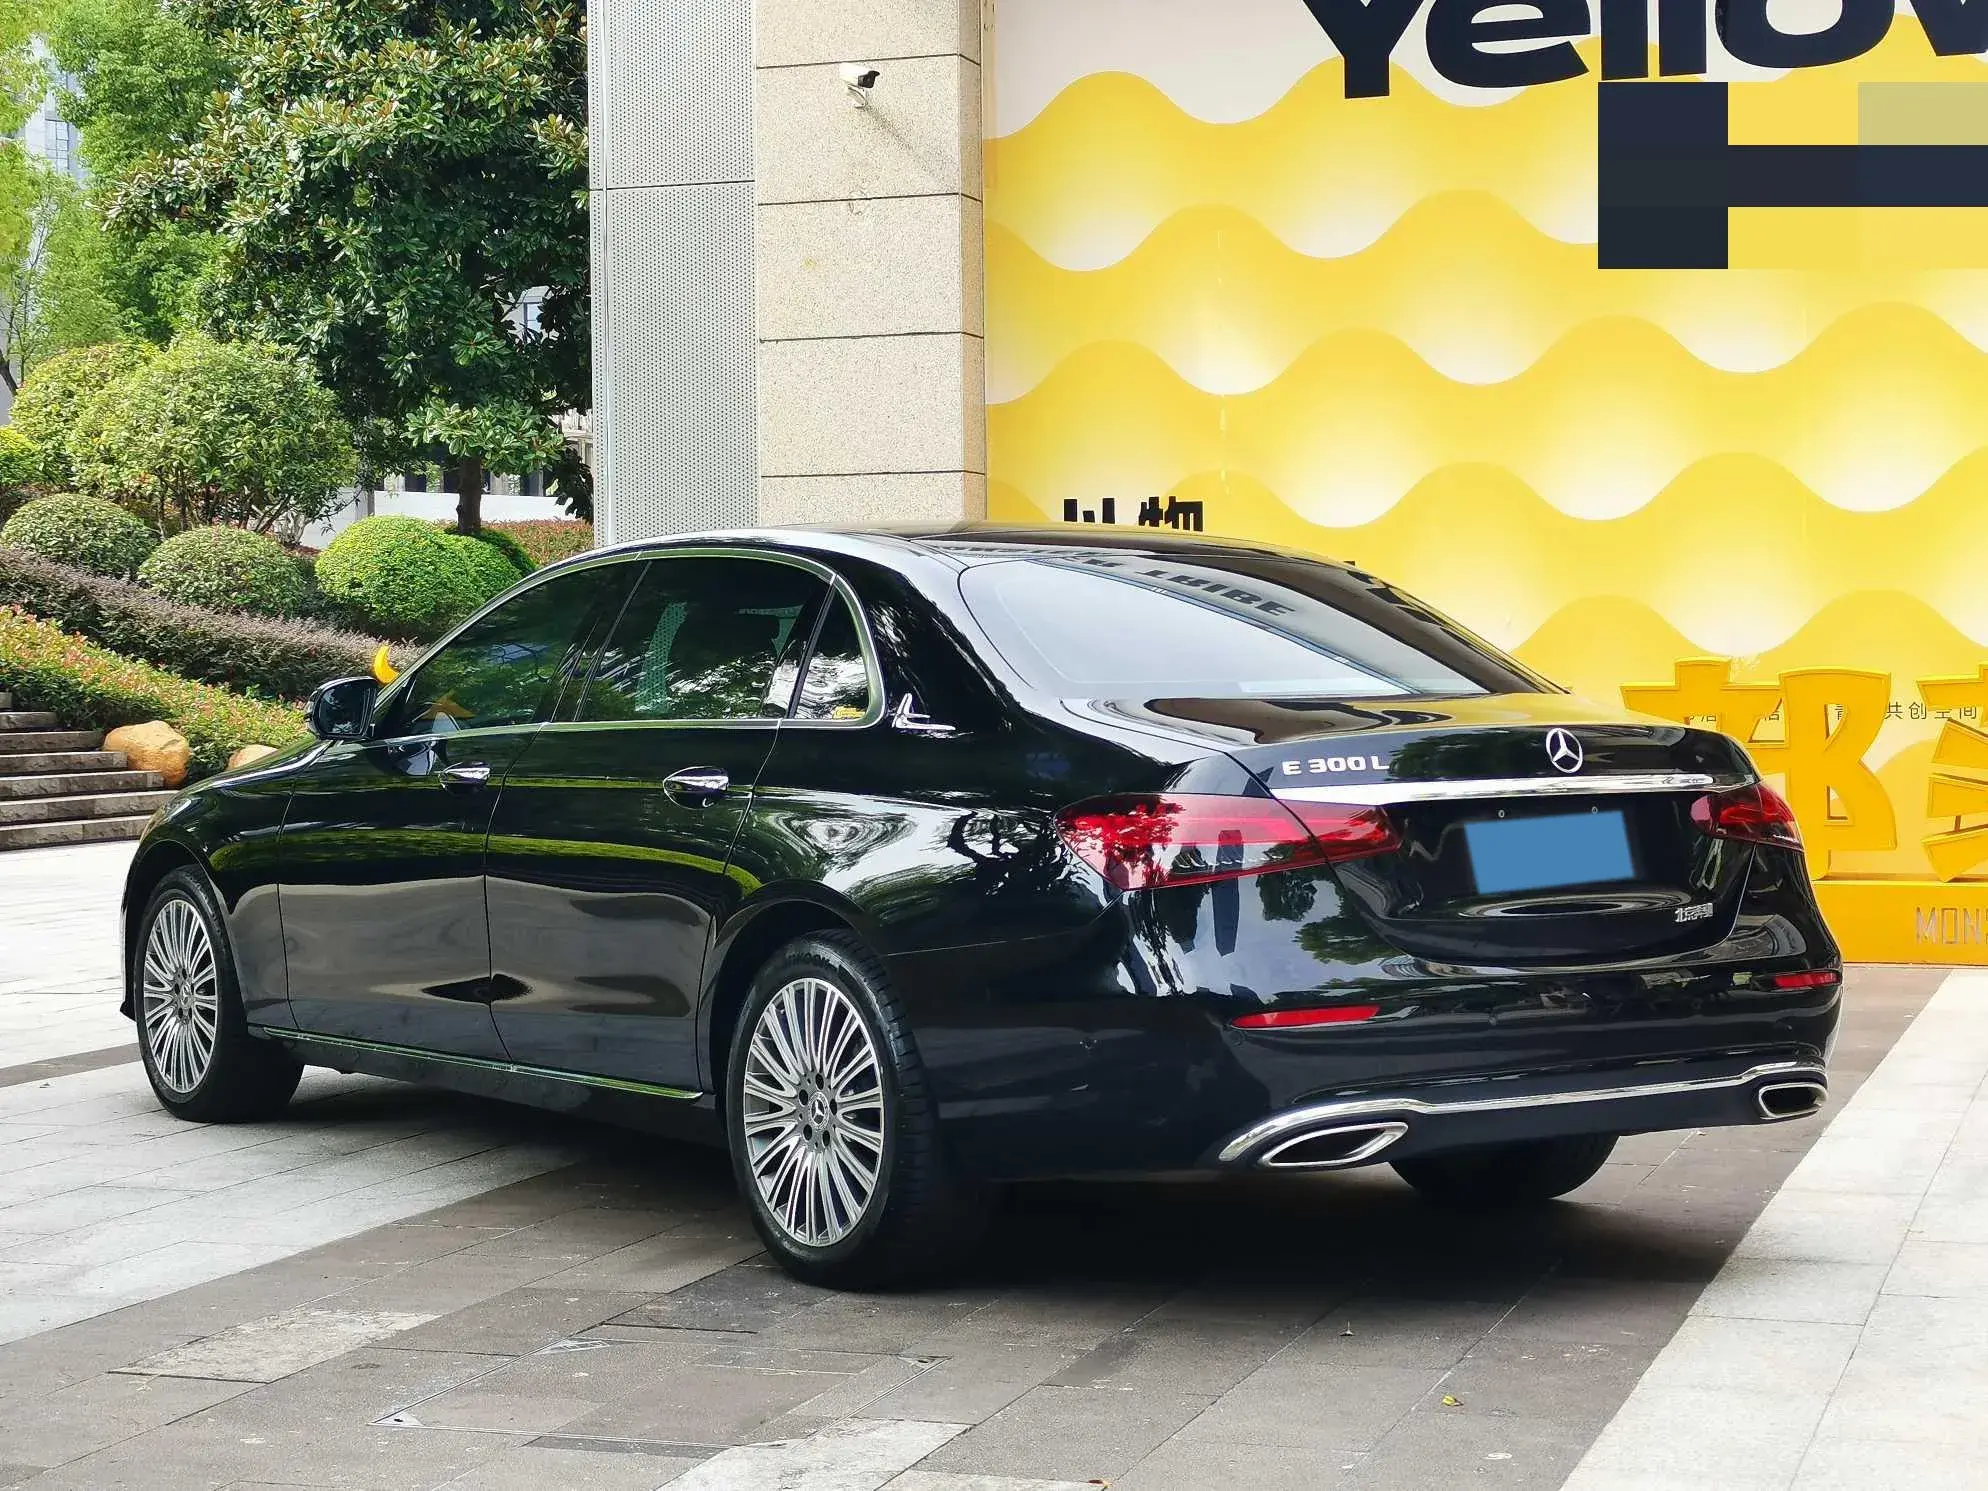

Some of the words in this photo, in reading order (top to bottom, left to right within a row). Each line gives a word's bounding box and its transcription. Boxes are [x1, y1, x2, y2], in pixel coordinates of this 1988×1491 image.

[1282, 760, 1302, 776] E
[1308, 756, 1367, 773] 300
[1371, 755, 1391, 770] L
[1916, 906, 1988, 945] MON
